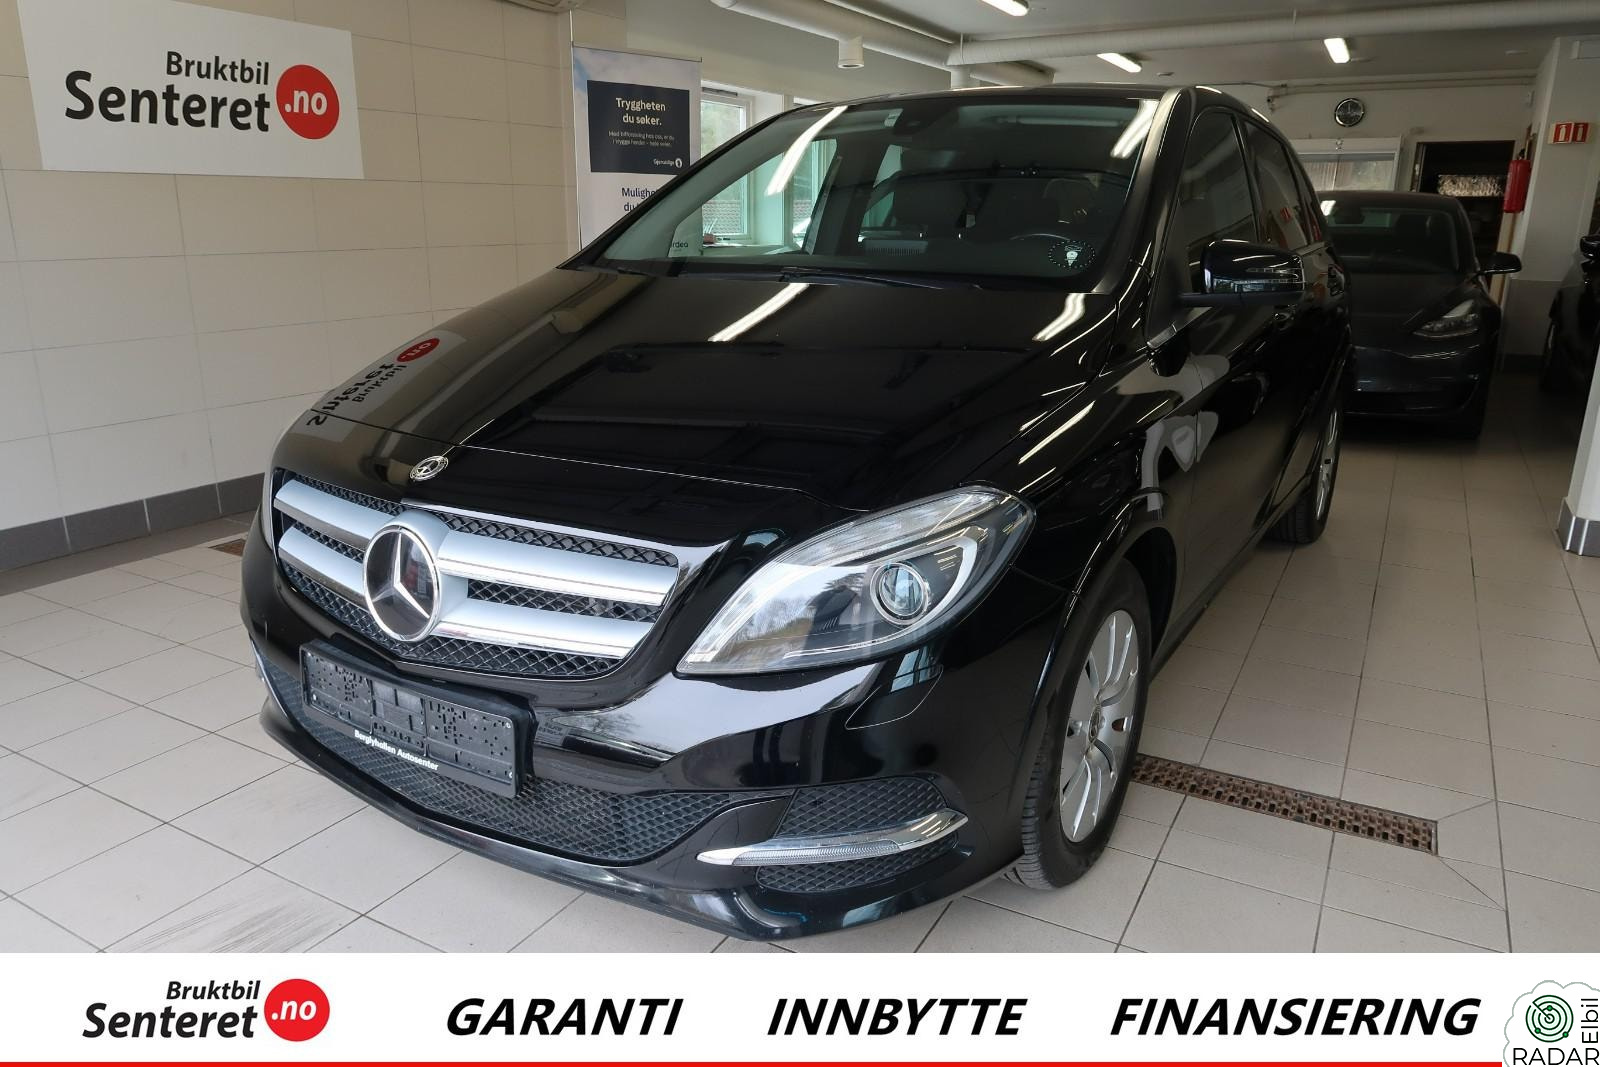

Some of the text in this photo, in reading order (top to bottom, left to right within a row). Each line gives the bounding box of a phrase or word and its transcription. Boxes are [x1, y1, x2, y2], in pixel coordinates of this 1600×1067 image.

[166, 51, 269, 86] Bruktbil
[65, 70, 271, 132] Senteret
[284, 91, 328, 116] .no
[615, 97, 666, 112] Tryggheten
[622, 113, 662, 126] du søker.
[621, 187, 658, 200] Mulighe
[396, 748, 440, 771] Autosenter
